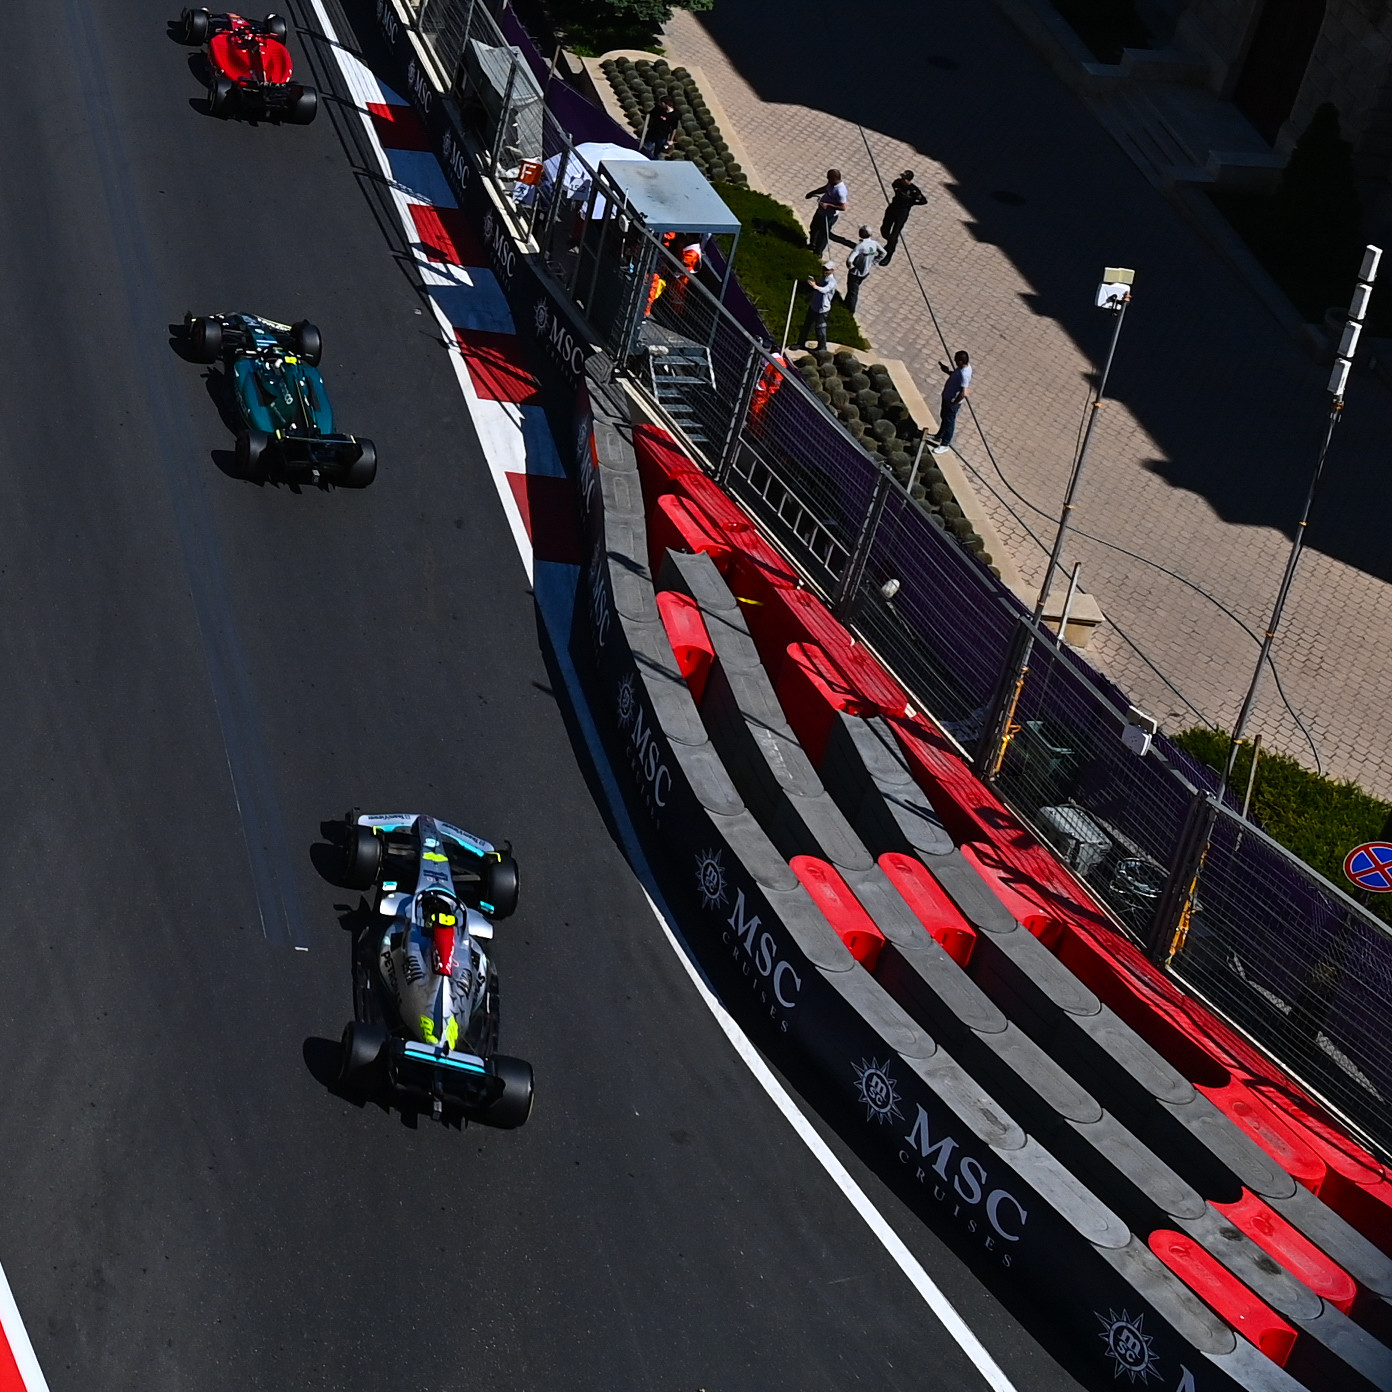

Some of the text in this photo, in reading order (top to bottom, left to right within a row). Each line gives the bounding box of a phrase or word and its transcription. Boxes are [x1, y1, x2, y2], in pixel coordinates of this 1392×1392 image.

[415, 70, 433, 114] MSC
[450, 140, 470, 189] MSC
[519, 163, 537, 180] F
[493, 224, 516, 278] MSC
[549, 314, 584, 375] MSC
[631, 704, 672, 808] MSC
[723, 931, 788, 1033] CRUISES
[727, 887, 802, 1008] MSC
[898, 1149, 1012, 1268] CRUISES
[904, 1102, 1028, 1242] MSC
